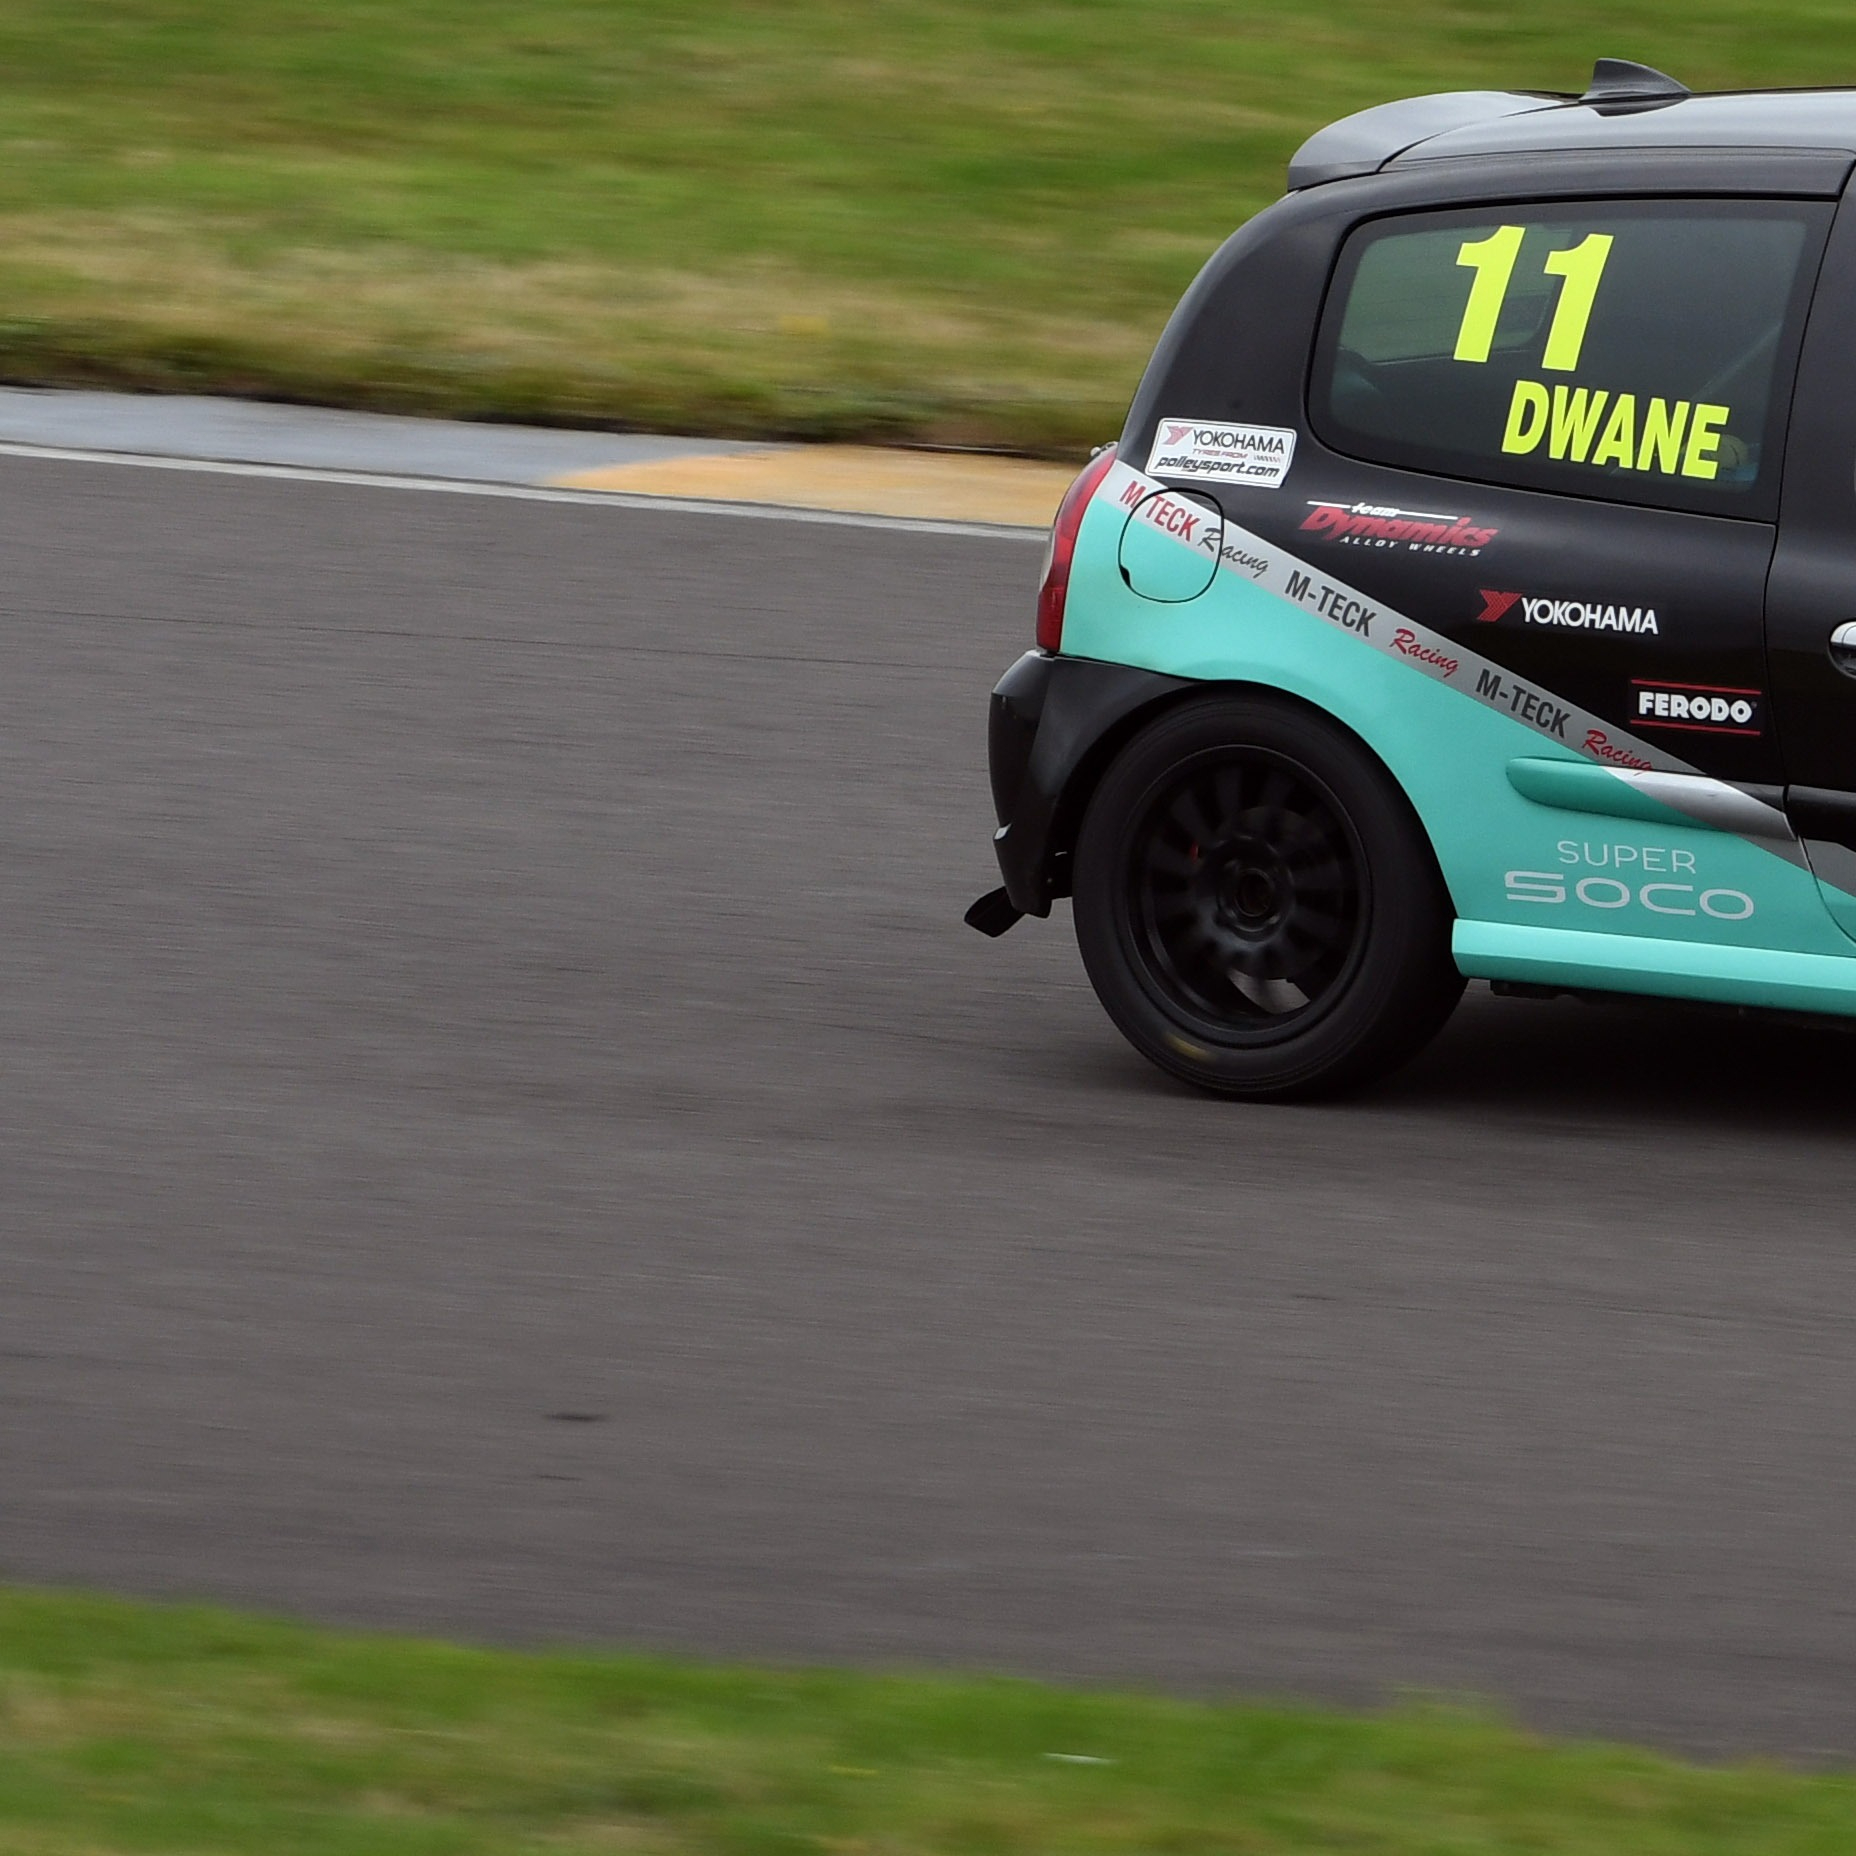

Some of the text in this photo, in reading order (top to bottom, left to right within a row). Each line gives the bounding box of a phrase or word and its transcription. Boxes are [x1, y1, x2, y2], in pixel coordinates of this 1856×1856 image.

[1453, 225, 1614, 372] 11
[1193, 429, 1285, 454] YOKOHAMA
[1502, 380, 1731, 480] DWANE
[1154, 456, 1280, 479] polleysport.com
[1298, 505, 1499, 547] Dynamics
[1351, 502, 1400, 518] team
[1339, 535, 1482, 557] ALLOY WHEELS
[1522, 597, 1659, 635] YOKOHAMA
[1198, 527, 1269, 579] Racing
[1284, 570, 1377, 637] M-TECK
[1388, 627, 1459, 678] Racing
[1475, 668, 1572, 739] M-TECK
[1581, 729, 1653, 776] Racing
[1638, 691, 1753, 724] FERODO
[1557, 840, 1696, 875] SUPER
[1504, 869, 1754, 920] SOCO
